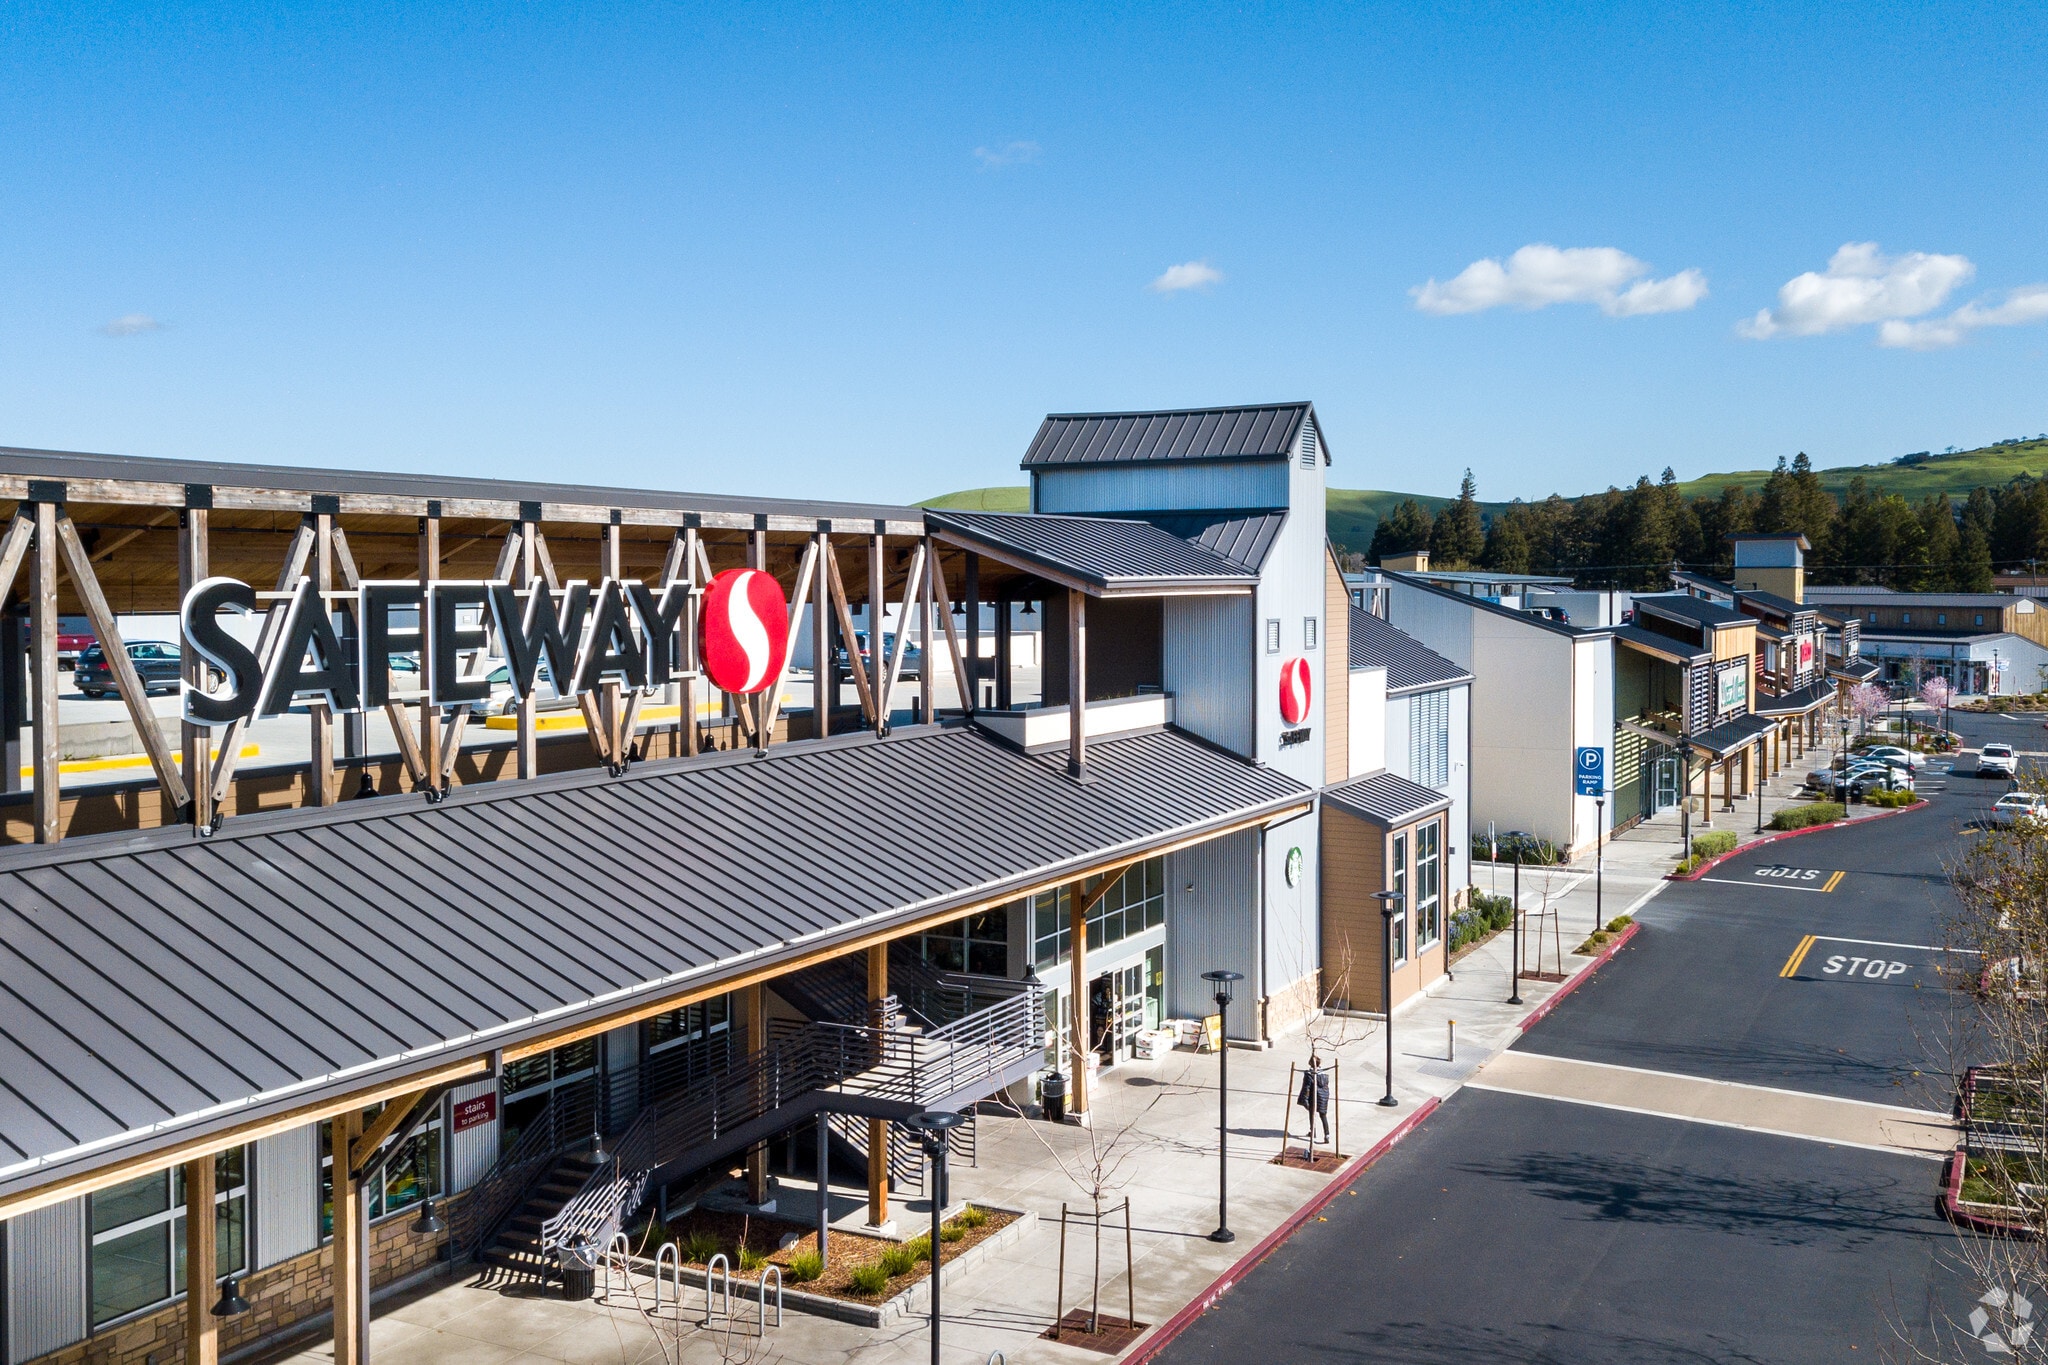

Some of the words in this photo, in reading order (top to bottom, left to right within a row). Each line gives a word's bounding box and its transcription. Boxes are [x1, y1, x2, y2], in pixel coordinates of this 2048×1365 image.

[180, 576, 692, 727] SAFEWAY
[1586, 752, 1597, 766] P
[1754, 867, 1821, 880] STOP
[1822, 955, 1909, 980] STOP
[464, 1101, 486, 1115] stairs
[461, 1118, 468, 1126] to
[469, 1111, 489, 1124] parking
